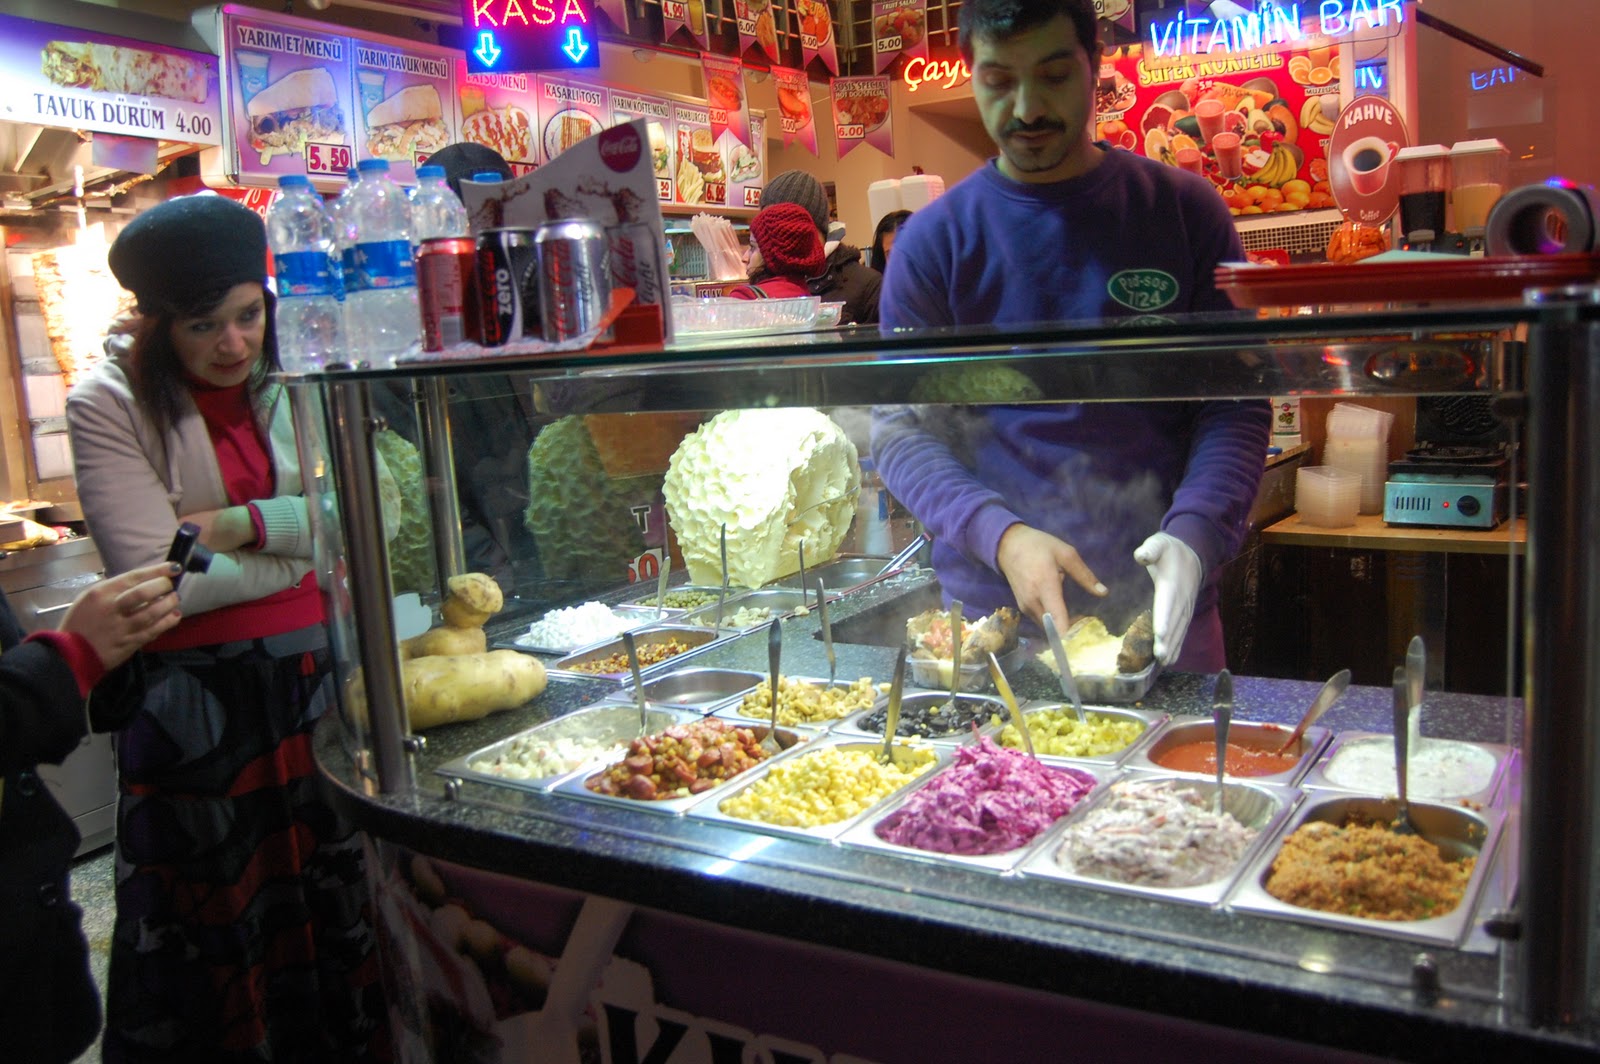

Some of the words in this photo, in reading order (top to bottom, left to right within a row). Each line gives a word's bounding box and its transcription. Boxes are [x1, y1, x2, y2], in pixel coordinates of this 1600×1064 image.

[472, 0, 588, 27] KASA
[882, 1, 898, 10] FRUIT
[1319, 0, 1403, 35] BAR
[237, 26, 283, 50] YARIM
[285, 35, 301, 53] ET
[303, 38, 342, 60] MENÜ
[877, 38, 902, 50] 5.00
[357, 47, 389, 68] YARIM
[389, 54, 420, 73] TAVUK
[421, 59, 448, 78] MENÜ
[500, 74, 527, 91] MENÜ
[857, 80, 887, 90] SPECIAL
[545, 84, 579, 102] KAŞARLI
[580, 92, 600, 106] TOST
[613, 96, 633, 111] YARIM
[633, 97, 652, 113] KÖFTE
[652, 101, 669, 117] MENÜ
[33, 93, 96, 121] TAVUK
[102, 97, 165, 130] DÜRÜM
[175, 109, 212, 136] 4.00
[676, 108, 708, 124] HAMBURGER
[1344, 103, 1393, 130] KAHVE
[838, 126, 863, 137] 6.00
[309, 145, 349, 172] 5.50
[496, 268, 513, 315] zero
